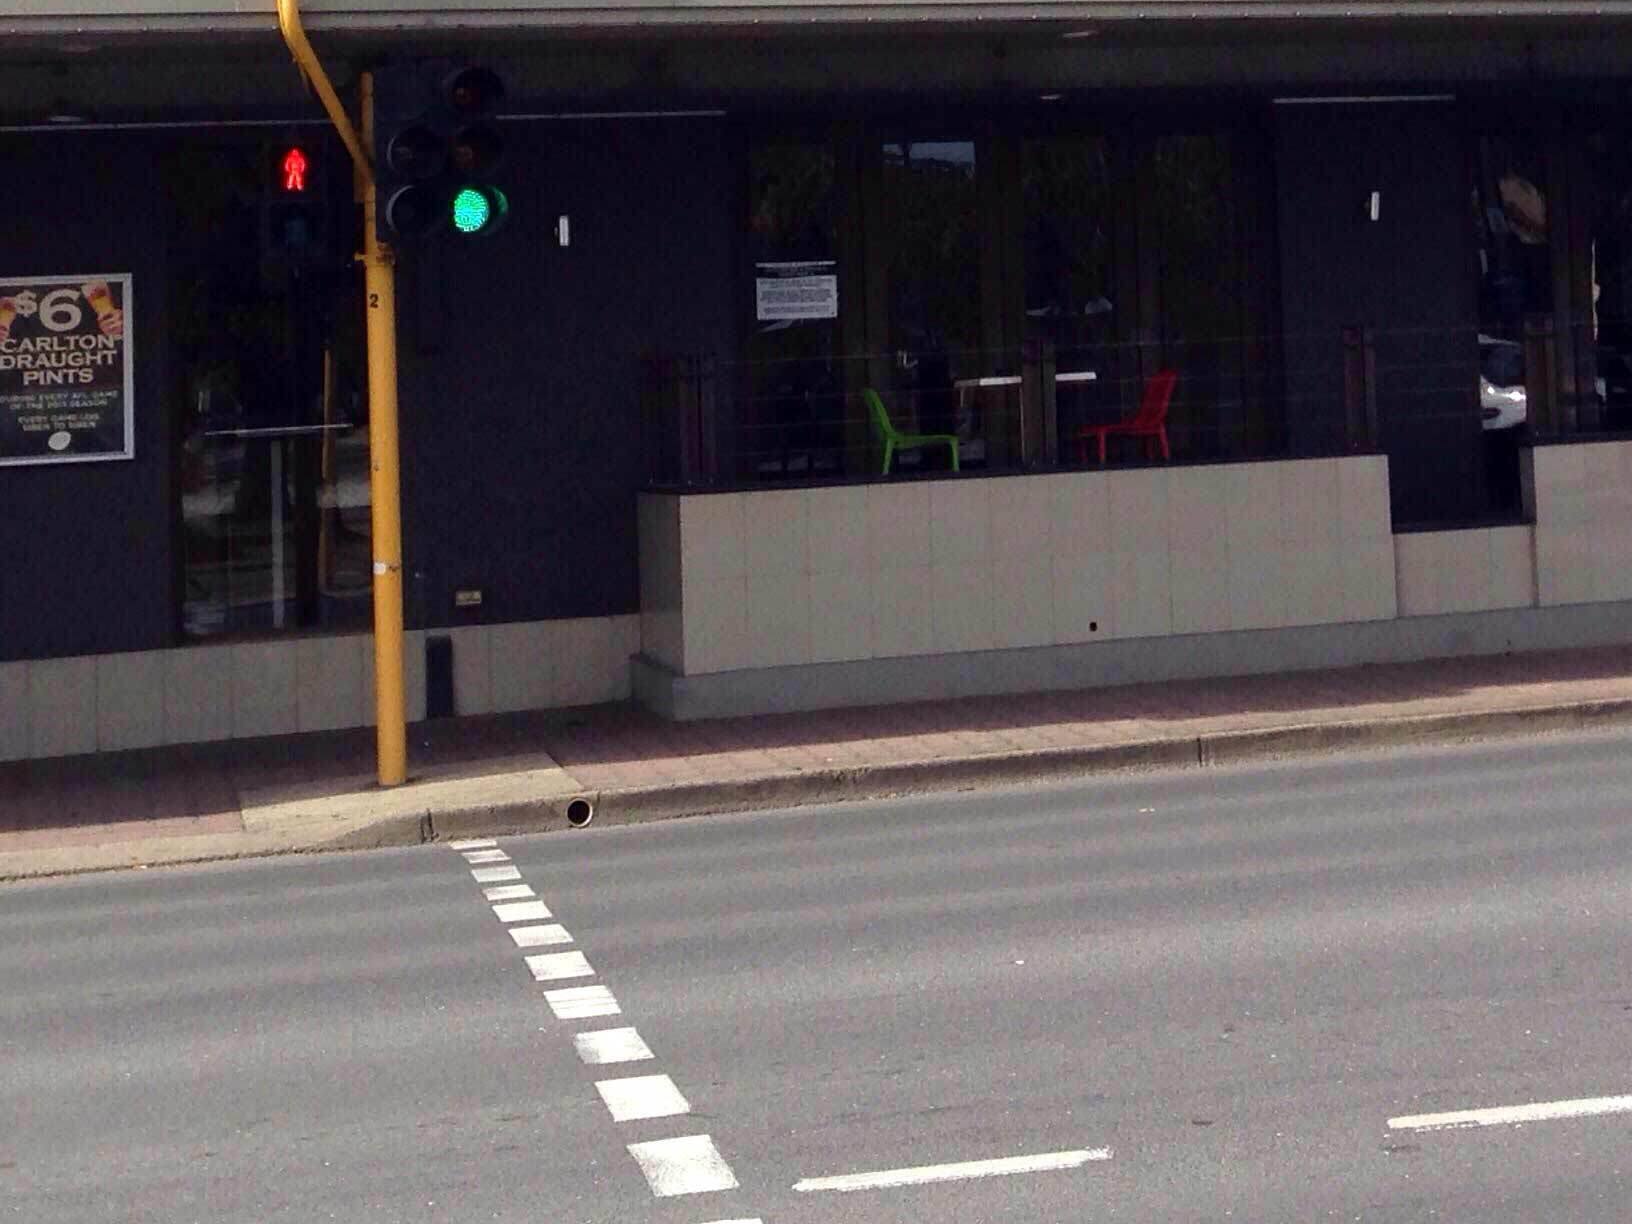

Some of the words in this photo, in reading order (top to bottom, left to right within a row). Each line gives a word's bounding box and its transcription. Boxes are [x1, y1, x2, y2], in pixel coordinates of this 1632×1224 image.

[15, 288, 82, 332] $6
[370, 293, 379, 309] 2
[1, 334, 115, 353] CARLTON
[0, 350, 118, 370] DRAUGHT
[23, 368, 94, 386] PINTS
